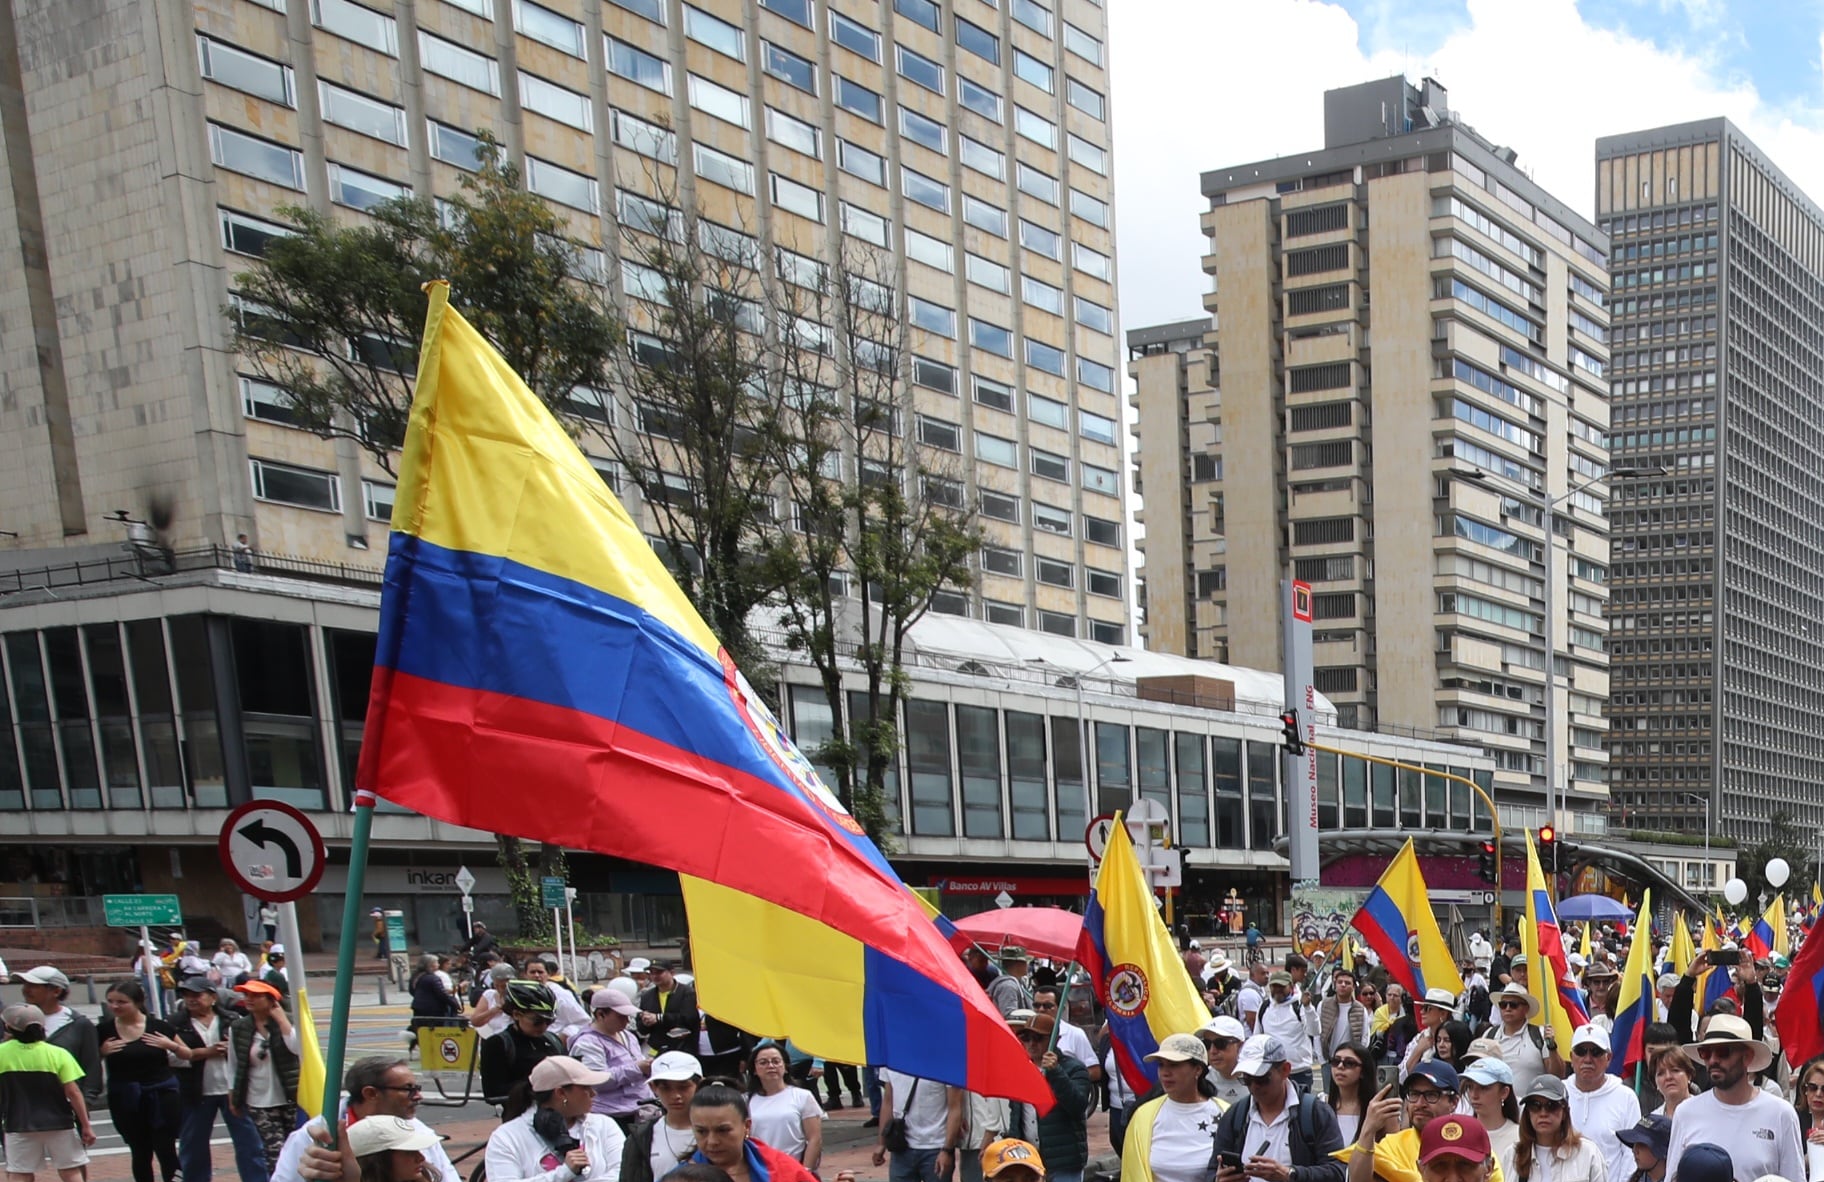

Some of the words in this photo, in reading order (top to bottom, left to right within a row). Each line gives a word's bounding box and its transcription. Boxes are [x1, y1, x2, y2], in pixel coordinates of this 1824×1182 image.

[1305, 684, 1314, 710] FNG
[1307, 725, 1316, 780] Nacional
[1309, 785, 1318, 829] Museo
[407, 868, 460, 885] inkan
[949, 881, 978, 891] Banco
[980, 882, 992, 890] AV
[993, 881, 1017, 891] Villas
